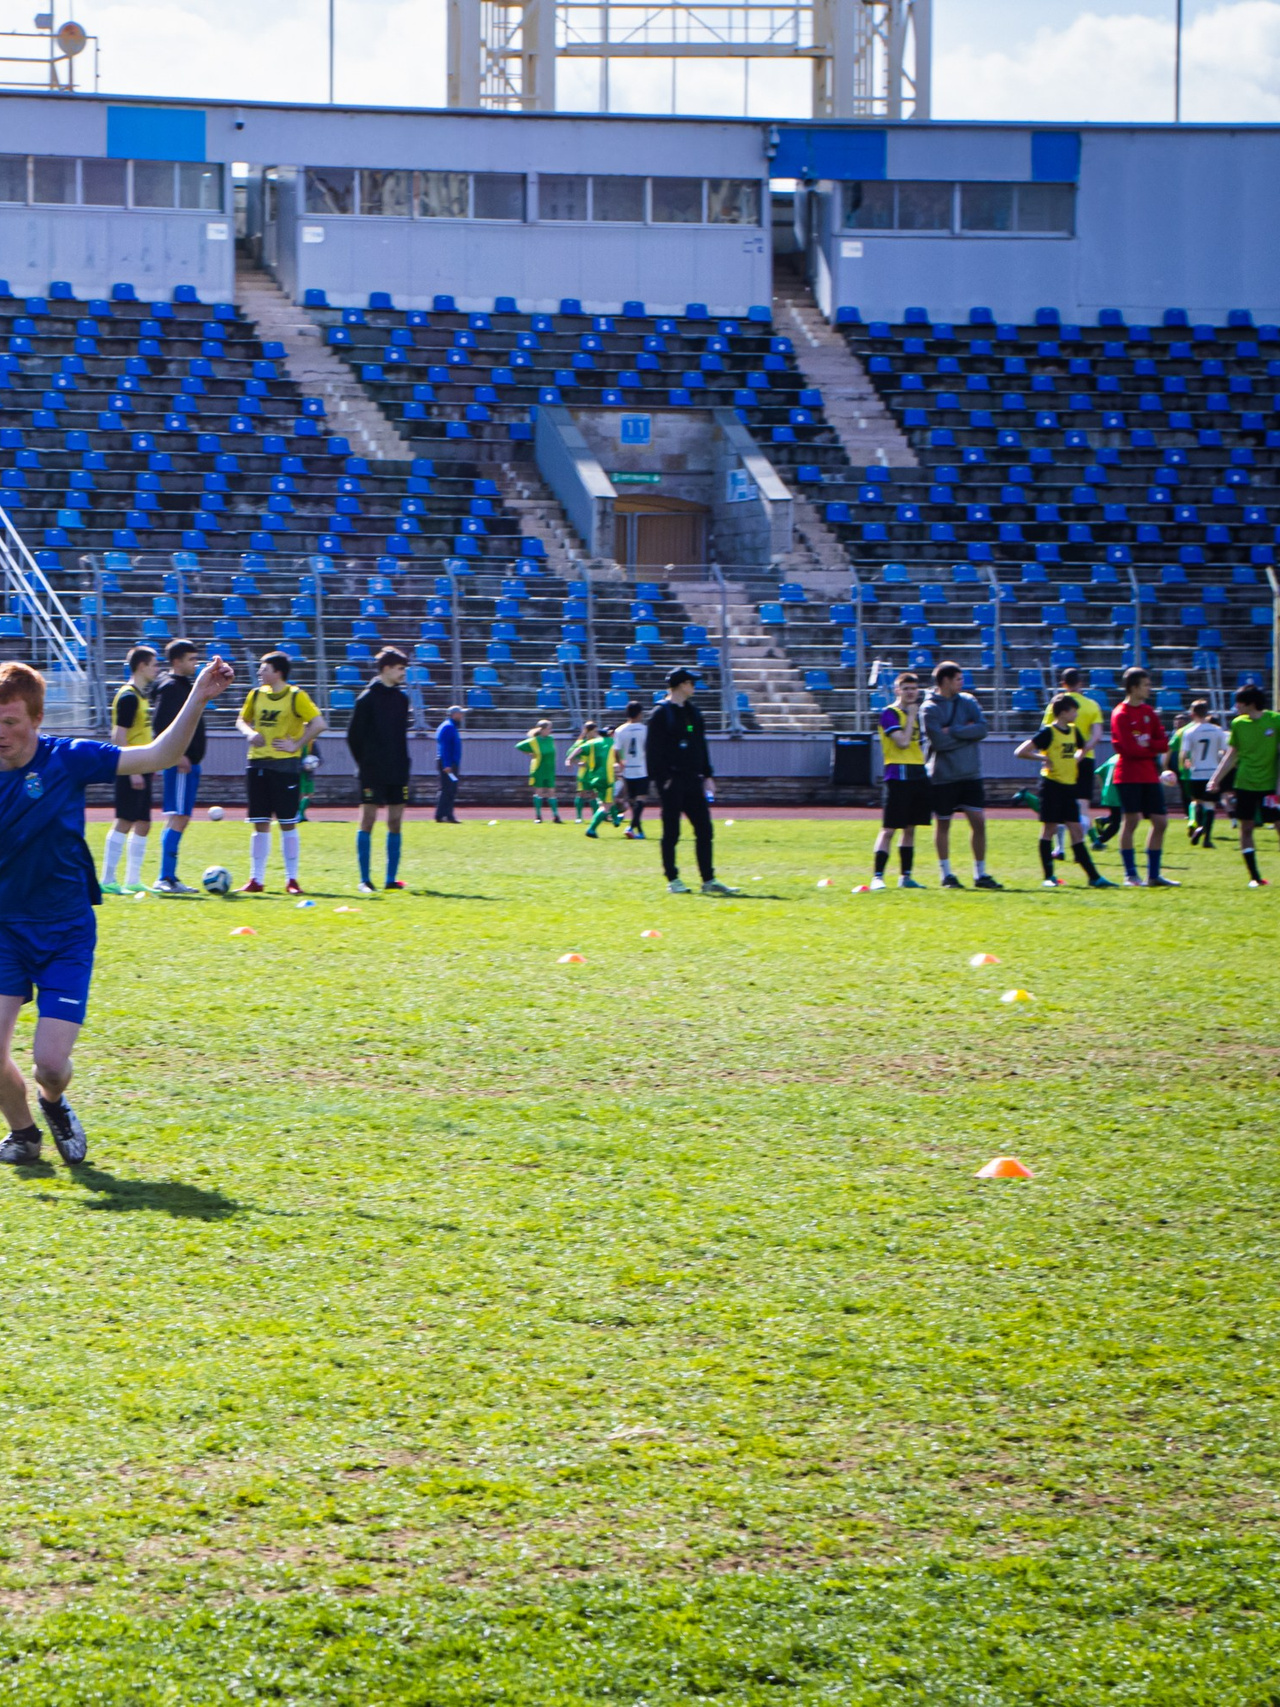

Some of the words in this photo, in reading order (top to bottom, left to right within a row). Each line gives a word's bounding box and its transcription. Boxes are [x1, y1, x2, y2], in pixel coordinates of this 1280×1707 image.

[627, 421, 645, 436] 11
[628, 737, 637, 758] 4
[1198, 738, 1211, 761] 7
